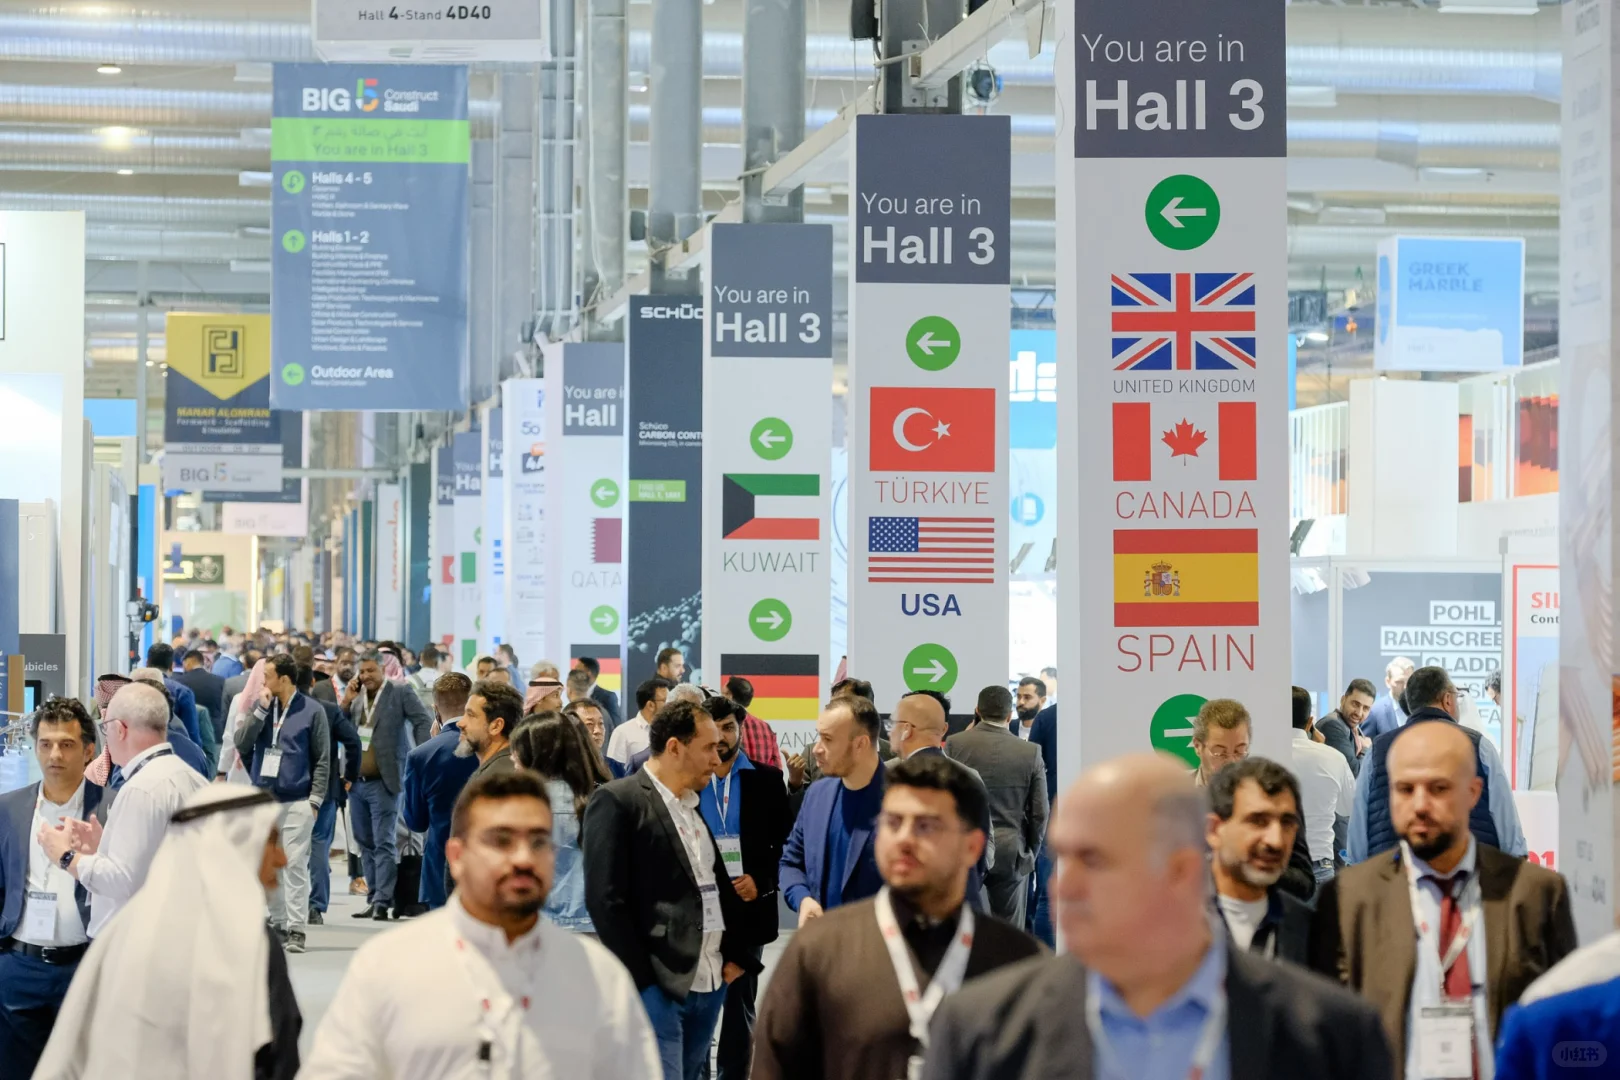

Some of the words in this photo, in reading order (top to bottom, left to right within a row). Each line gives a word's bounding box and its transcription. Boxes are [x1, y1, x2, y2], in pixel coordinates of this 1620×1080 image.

[358, 10, 384, 20] Hall
[446, 5, 491, 20] 4D40
[1081, 33, 1144, 62] You
[1155, 40, 1207, 62] are
[1218, 33, 1244, 62] in
[302, 87, 351, 112] BIG
[384, 89, 439, 101] Construct
[384, 101, 419, 112] Saudi
[1086, 79, 1206, 131] Hall
[1228, 78, 1265, 131] 3
[313, 143, 341, 156] You
[344, 145, 367, 156] are
[371, 143, 384, 156] in
[387, 143, 417, 156] Hall
[418, 143, 428, 157] 3
[312, 172, 343, 184] Halls
[344, 172, 354, 184] 4
[363, 172, 373, 184] 5
[861, 192, 907, 214] You
[915, 197, 954, 215] are
[961, 193, 981, 215] in
[312, 231, 343, 243] Halls
[344, 231, 351, 243] 1
[359, 231, 370, 243] 2
[863, 226, 952, 264] Hall
[968, 226, 995, 265] 3
[1408, 262, 1470, 276] GREEK
[1408, 277, 1483, 293] MARBLE
[714, 285, 752, 304] You
[756, 289, 788, 304] are
[793, 286, 809, 304] in
[715, 312, 787, 343] Hall
[798, 312, 821, 344] 3
[311, 366, 362, 379] Outdoor
[364, 366, 394, 379] Area
[564, 385, 592, 399] You
[594, 387, 617, 399] are
[1113, 379, 1173, 394] UNITED
[1179, 379, 1255, 394] KINGDOM
[177, 407, 216, 417] MANAR
[565, 404, 617, 427] Hall
[639, 421, 669, 430] Schüco
[639, 430, 676, 440] CARBON
[180, 467, 209, 482] BIG
[874, 476, 989, 504] TÜRKIYE
[1116, 490, 1257, 519] CANADA
[723, 552, 820, 573] KUWAIT
[901, 593, 962, 616] USA
[1433, 605, 1492, 621] POHL
[1117, 634, 1254, 672] SPAIN
